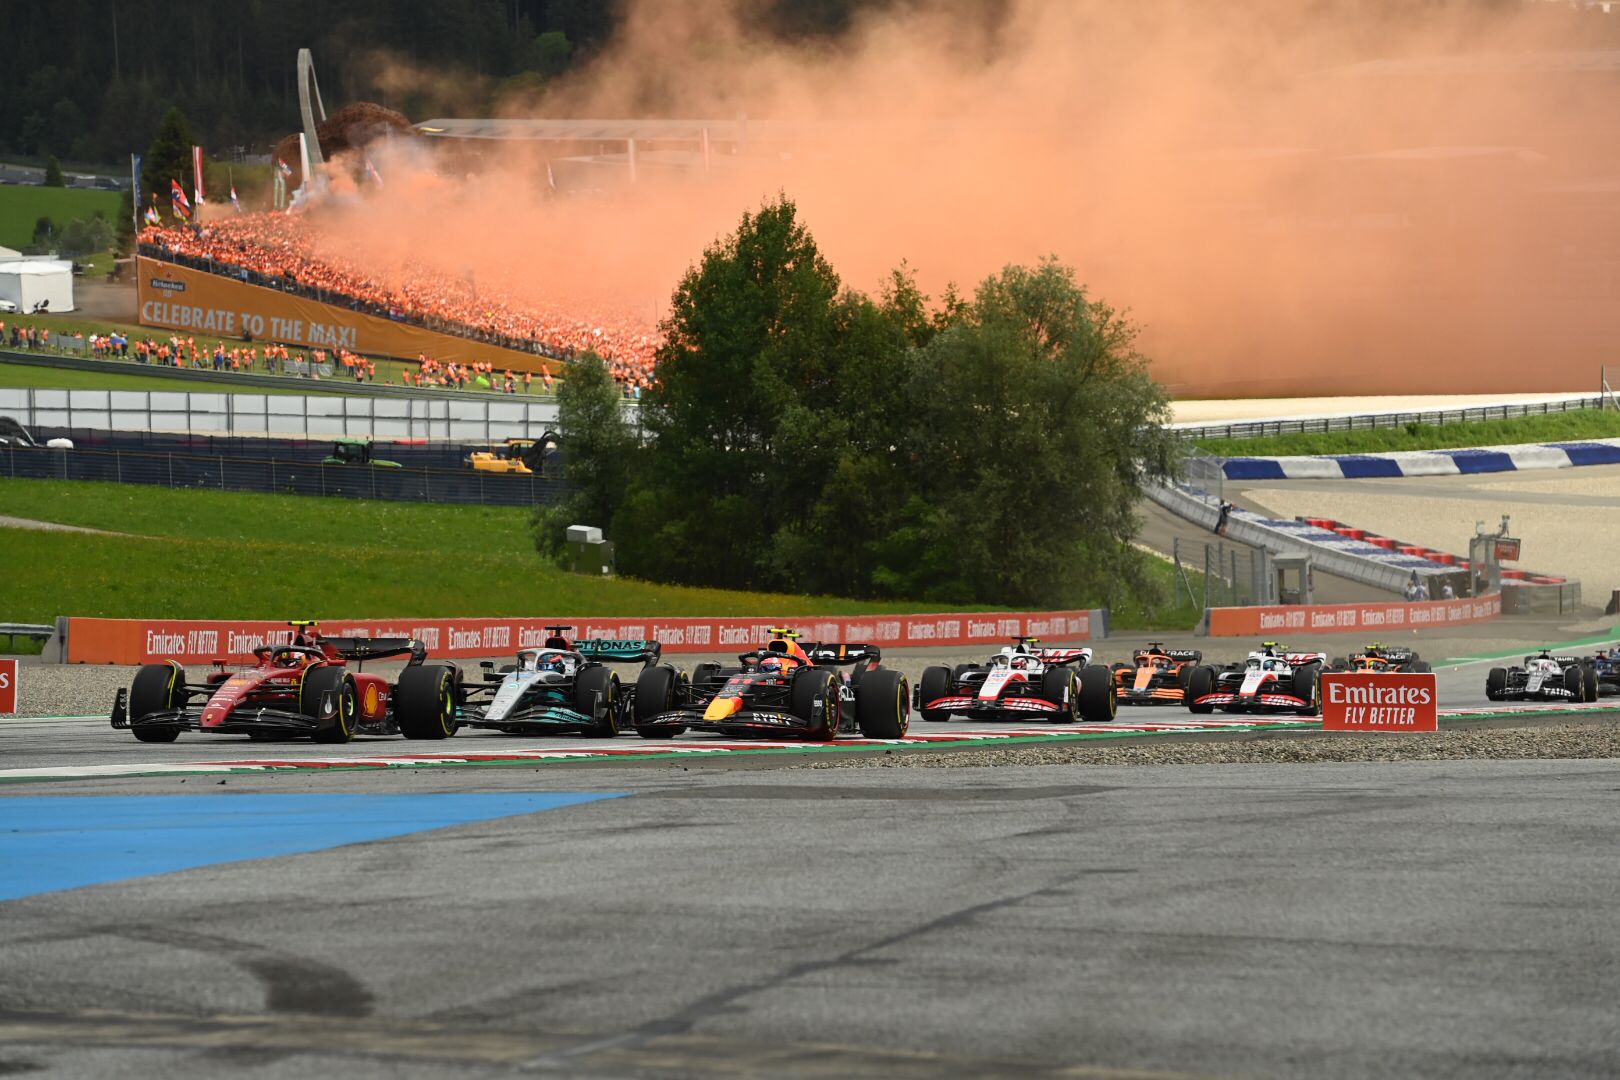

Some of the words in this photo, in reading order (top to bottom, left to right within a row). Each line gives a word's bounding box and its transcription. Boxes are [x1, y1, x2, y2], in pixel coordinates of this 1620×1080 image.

[142, 300, 234, 332] CELEBRATE
[241, 313, 265, 337] TO
[270, 317, 303, 341] THE
[308, 322, 357, 348] MAX!
[147, 630, 185, 655] Emirates
[188, 631, 198, 655] FLY
[198, 631, 218, 655] BETTER
[448, 626, 481, 650] Emirates
[653, 624, 684, 645] Emirates
[719, 625, 749, 645] Emirates
[1328, 682, 1431, 705] Emirates
[1344, 706, 1366, 724] FLY
[1369, 706, 1415, 725] BETTER
